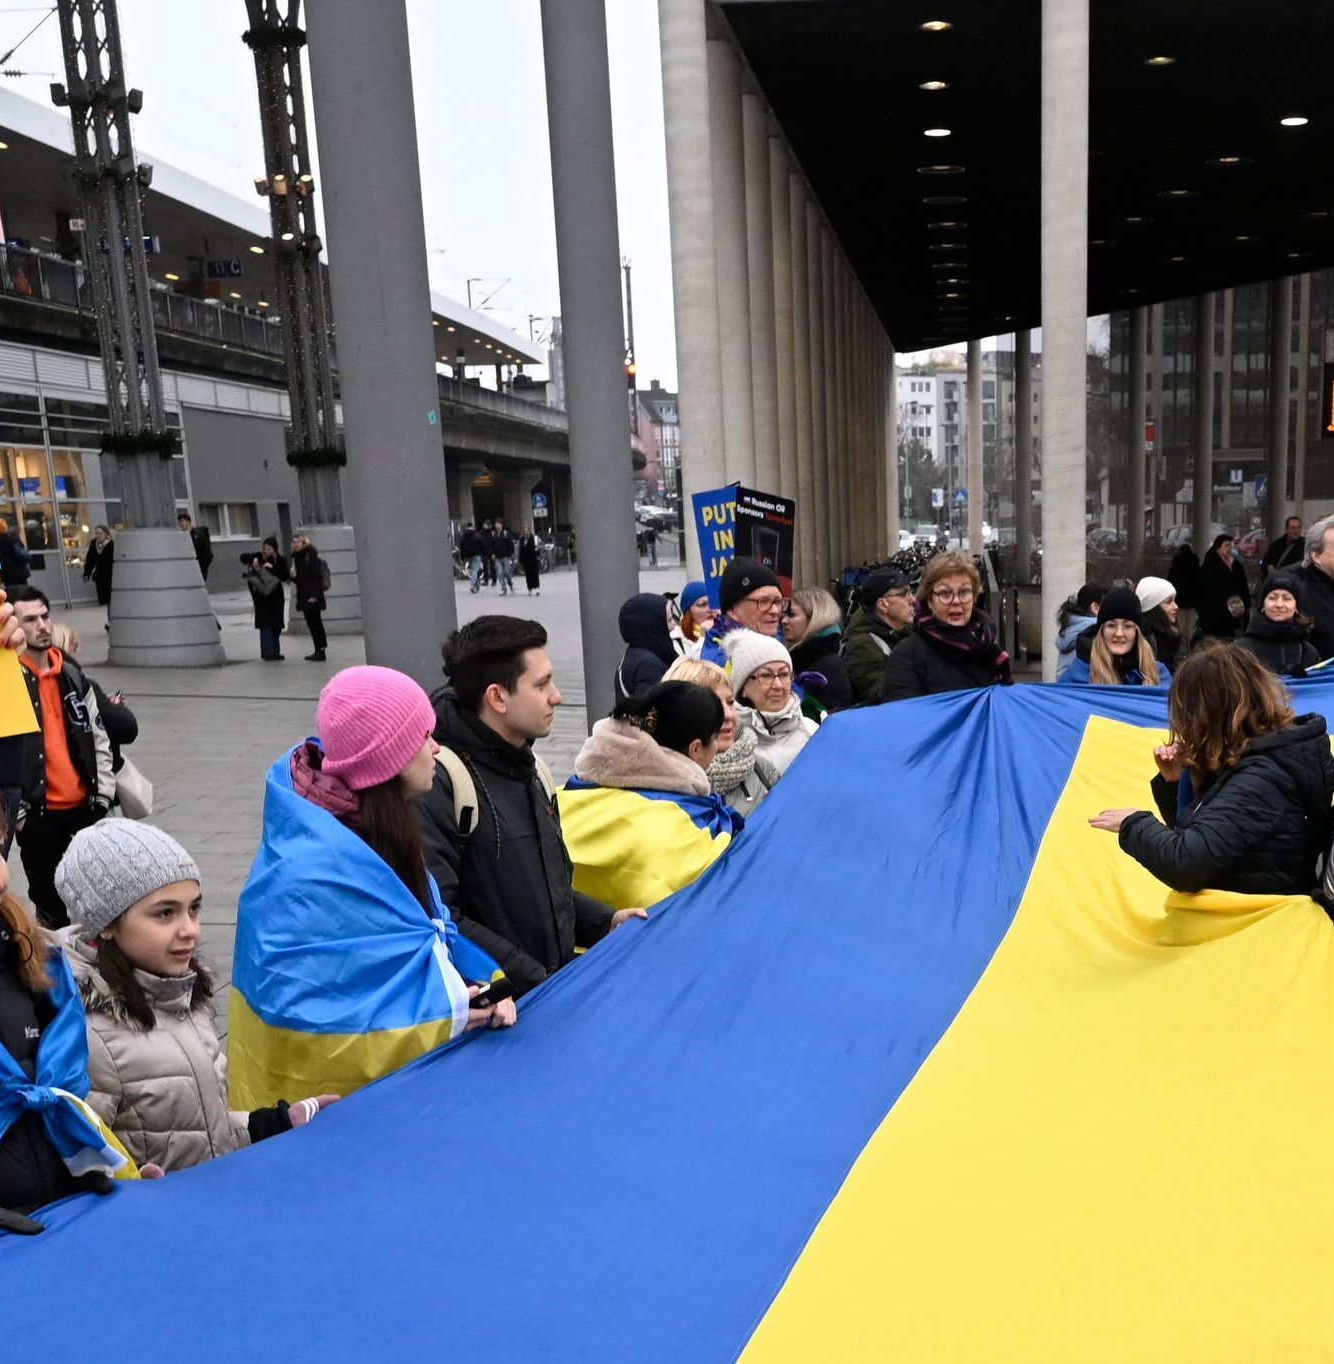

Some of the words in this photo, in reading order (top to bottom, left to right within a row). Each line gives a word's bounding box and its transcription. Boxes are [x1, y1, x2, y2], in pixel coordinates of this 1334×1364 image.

[702, 502, 736, 527] PUT
[737, 504, 764, 519] Sponsors
[752, 498, 775, 511] Russian
[713, 528, 735, 552] IN
[710, 555, 735, 577] JA
